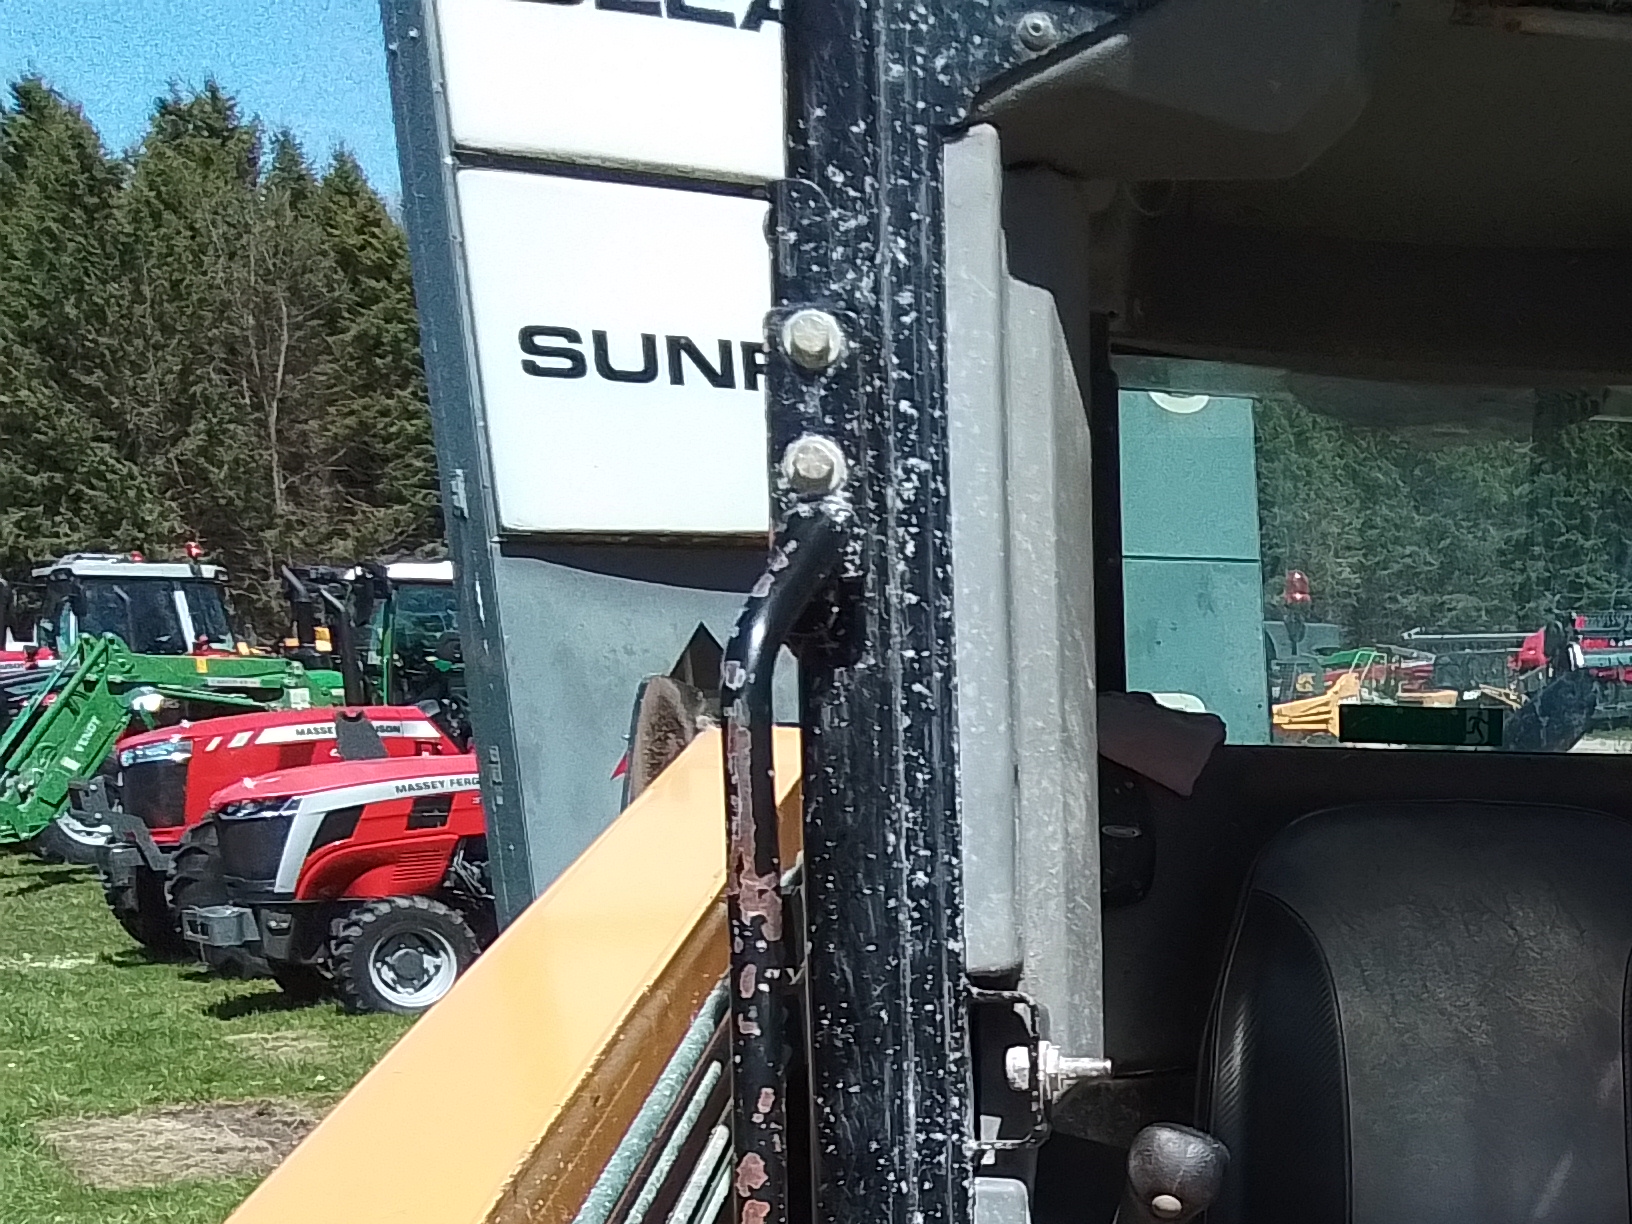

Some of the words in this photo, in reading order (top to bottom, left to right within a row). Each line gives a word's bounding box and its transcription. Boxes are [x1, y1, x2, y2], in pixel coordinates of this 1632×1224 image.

[74, 715, 101, 751] FENDT
[295, 726, 334, 736] MASSE
[395, 779, 445, 793] MASSEY
